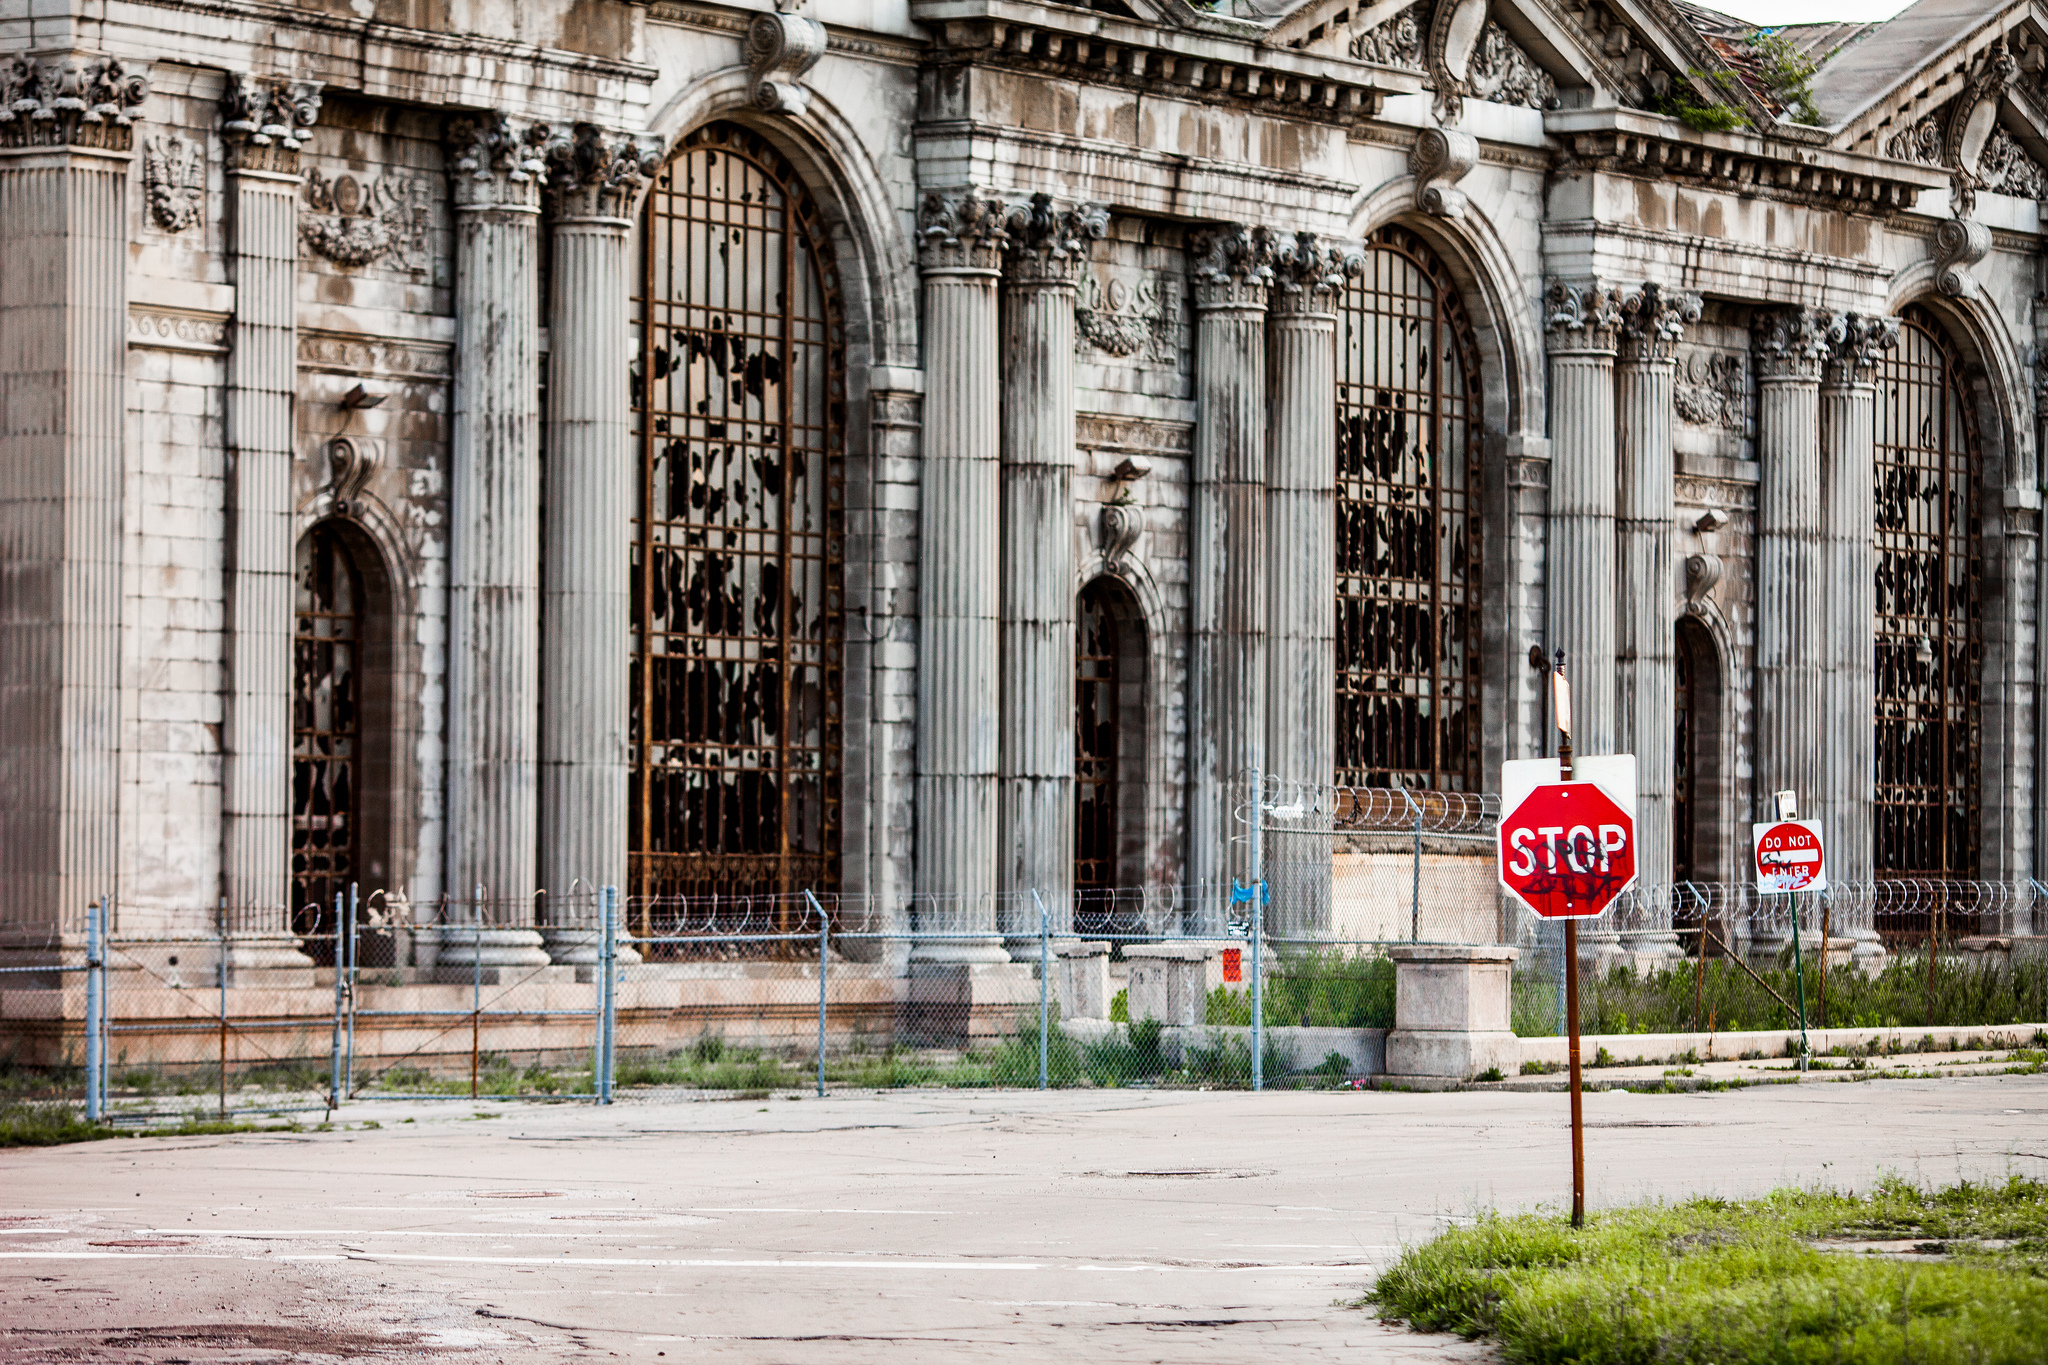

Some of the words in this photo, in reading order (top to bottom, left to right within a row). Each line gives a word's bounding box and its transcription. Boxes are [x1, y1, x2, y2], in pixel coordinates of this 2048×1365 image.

[1509, 824, 1627, 876] STOP
[1765, 837, 1782, 849] DO
[1788, 835, 1812, 848] NOT
